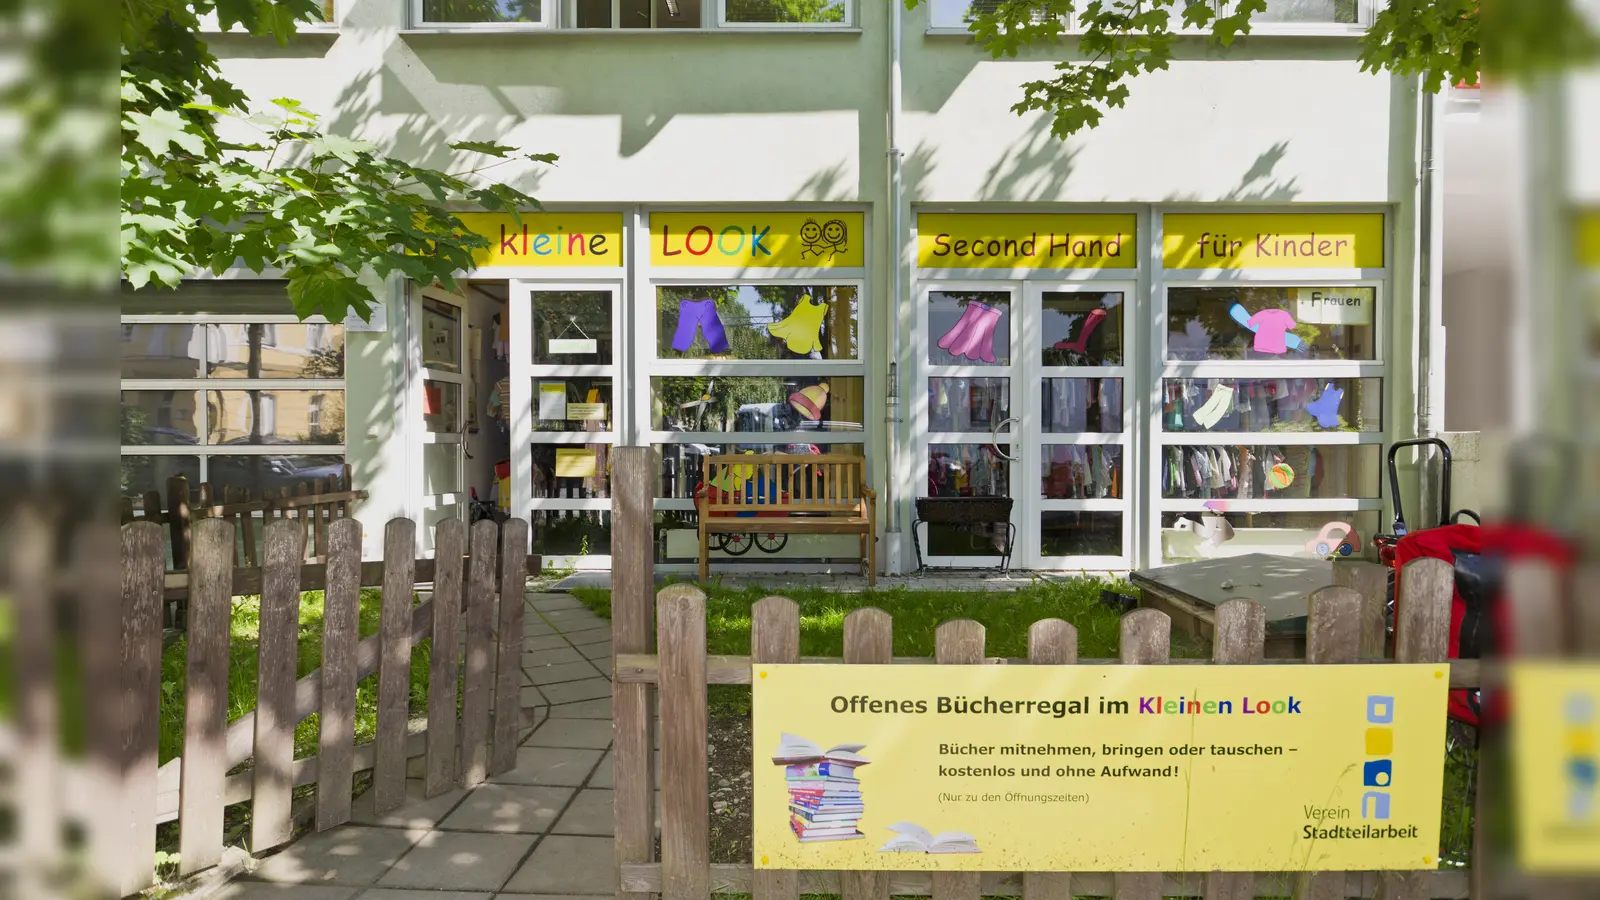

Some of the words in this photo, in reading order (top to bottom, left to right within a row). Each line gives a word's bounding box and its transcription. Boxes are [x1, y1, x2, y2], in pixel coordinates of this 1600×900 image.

[500, 224, 608, 256] kleine
[662, 225, 772, 257] LOOK
[932, 233, 1037, 258] Second
[1049, 233, 1122, 258] Hand
[1197, 231, 1243, 259] für
[1255, 233, 1348, 258] Kinder
[1311, 291, 1361, 308] Frauen
[830, 695, 928, 714] Offenes
[937, 695, 1090, 719] Bücherregal
[1099, 696, 1129, 715] im
[1139, 696, 1232, 715] Kleinen
[1242, 695, 1302, 715] Look
[938, 743, 996, 756] Bücher
[1000, 743, 1096, 758] mitnehmen,
[1102, 743, 1164, 759] bringen
[1168, 743, 1206, 756] oder
[1210, 743, 1283, 756] tauschen
[938, 765, 1016, 777] kostenlos
[1020, 765, 1051, 777] und
[1055, 765, 1096, 777] ohne
[938, 792, 963, 804] (Nur
[965, 794, 978, 803] zu
[981, 792, 1001, 803] den
[1004, 791, 1090, 804] Öffnungszeiten)
[1303, 805, 1350, 820] Verein
[1303, 823, 1418, 840] Stadtteilarbeit
